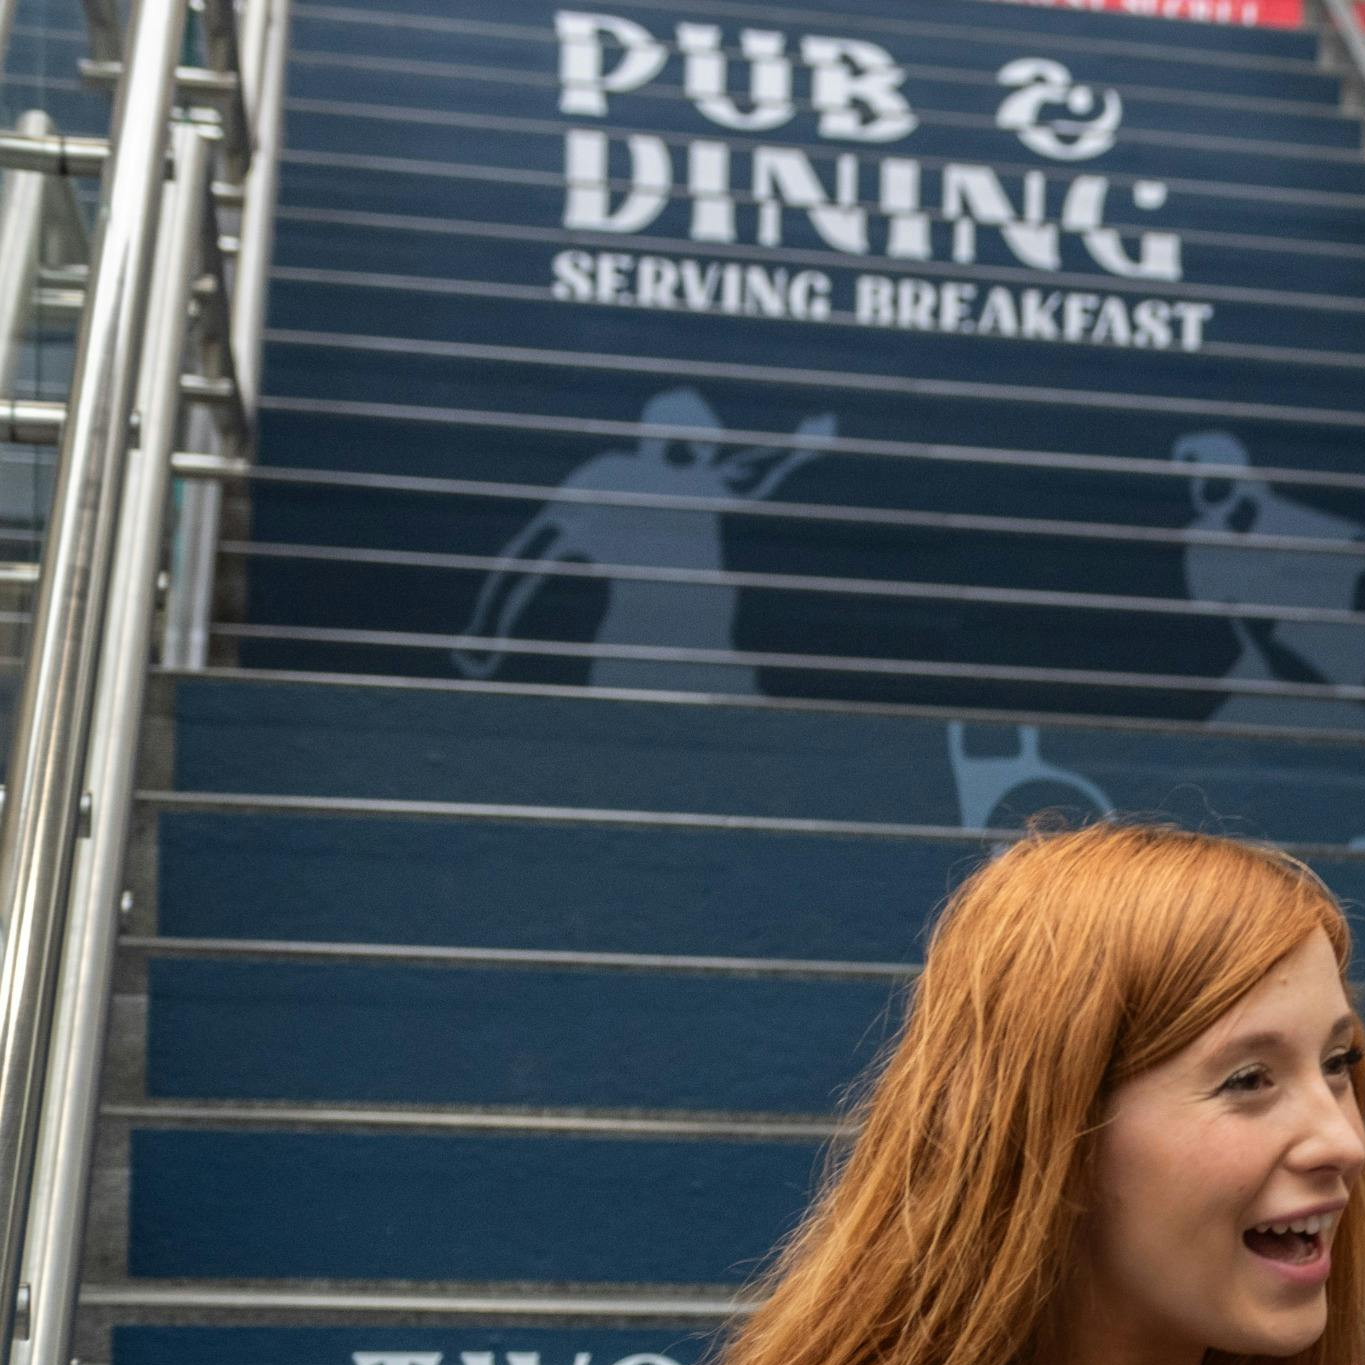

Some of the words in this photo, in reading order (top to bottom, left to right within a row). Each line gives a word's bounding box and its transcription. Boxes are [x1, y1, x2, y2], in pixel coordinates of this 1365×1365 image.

[554, 10, 919, 143] PUB
[996, 58, 1123, 161] &
[562, 129, 1183, 283] DINING
[552, 250, 831, 321] SERVING
[855, 276, 1214, 352] BREAKFAST
